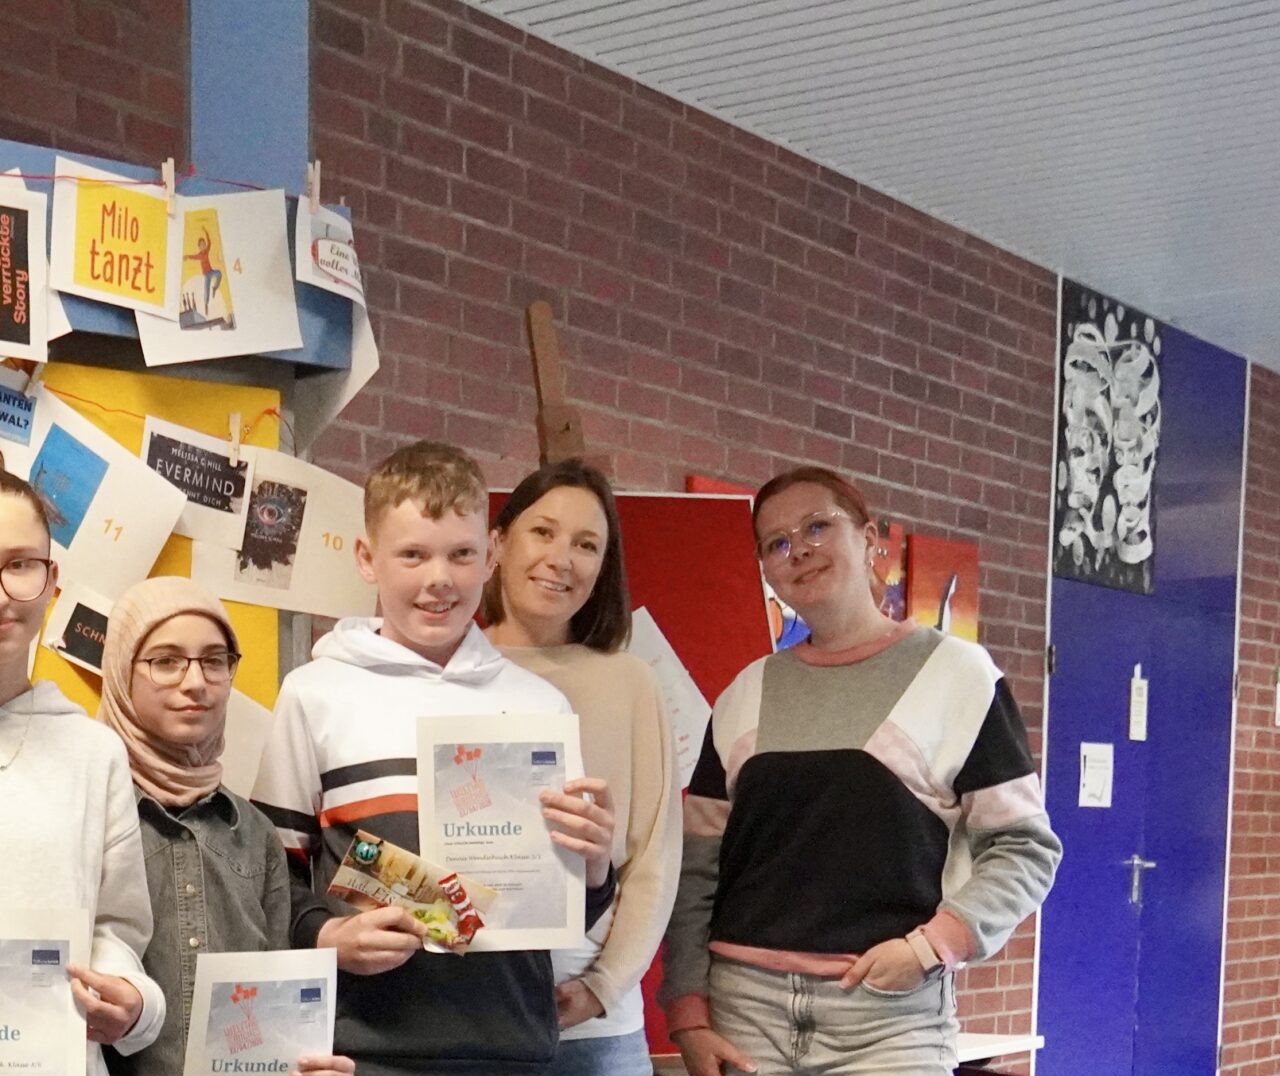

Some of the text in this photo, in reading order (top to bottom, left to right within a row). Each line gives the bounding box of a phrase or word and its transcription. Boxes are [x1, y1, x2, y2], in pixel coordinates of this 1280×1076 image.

[101, 200, 140, 244] Milo
[89, 239, 156, 294] tanzt
[232, 257, 243, 275] 4
[13, 269, 30, 324] Story
[155, 458, 235, 497] EVERMIND
[179, 487, 201, 500] ENNT
[103, 517, 125, 543] 11
[322, 532, 344, 551] 10
[72, 621, 108, 647] SCHN
[443, 821, 523, 838] Urkunde
[211, 1058, 289, 1073] Urkunde
